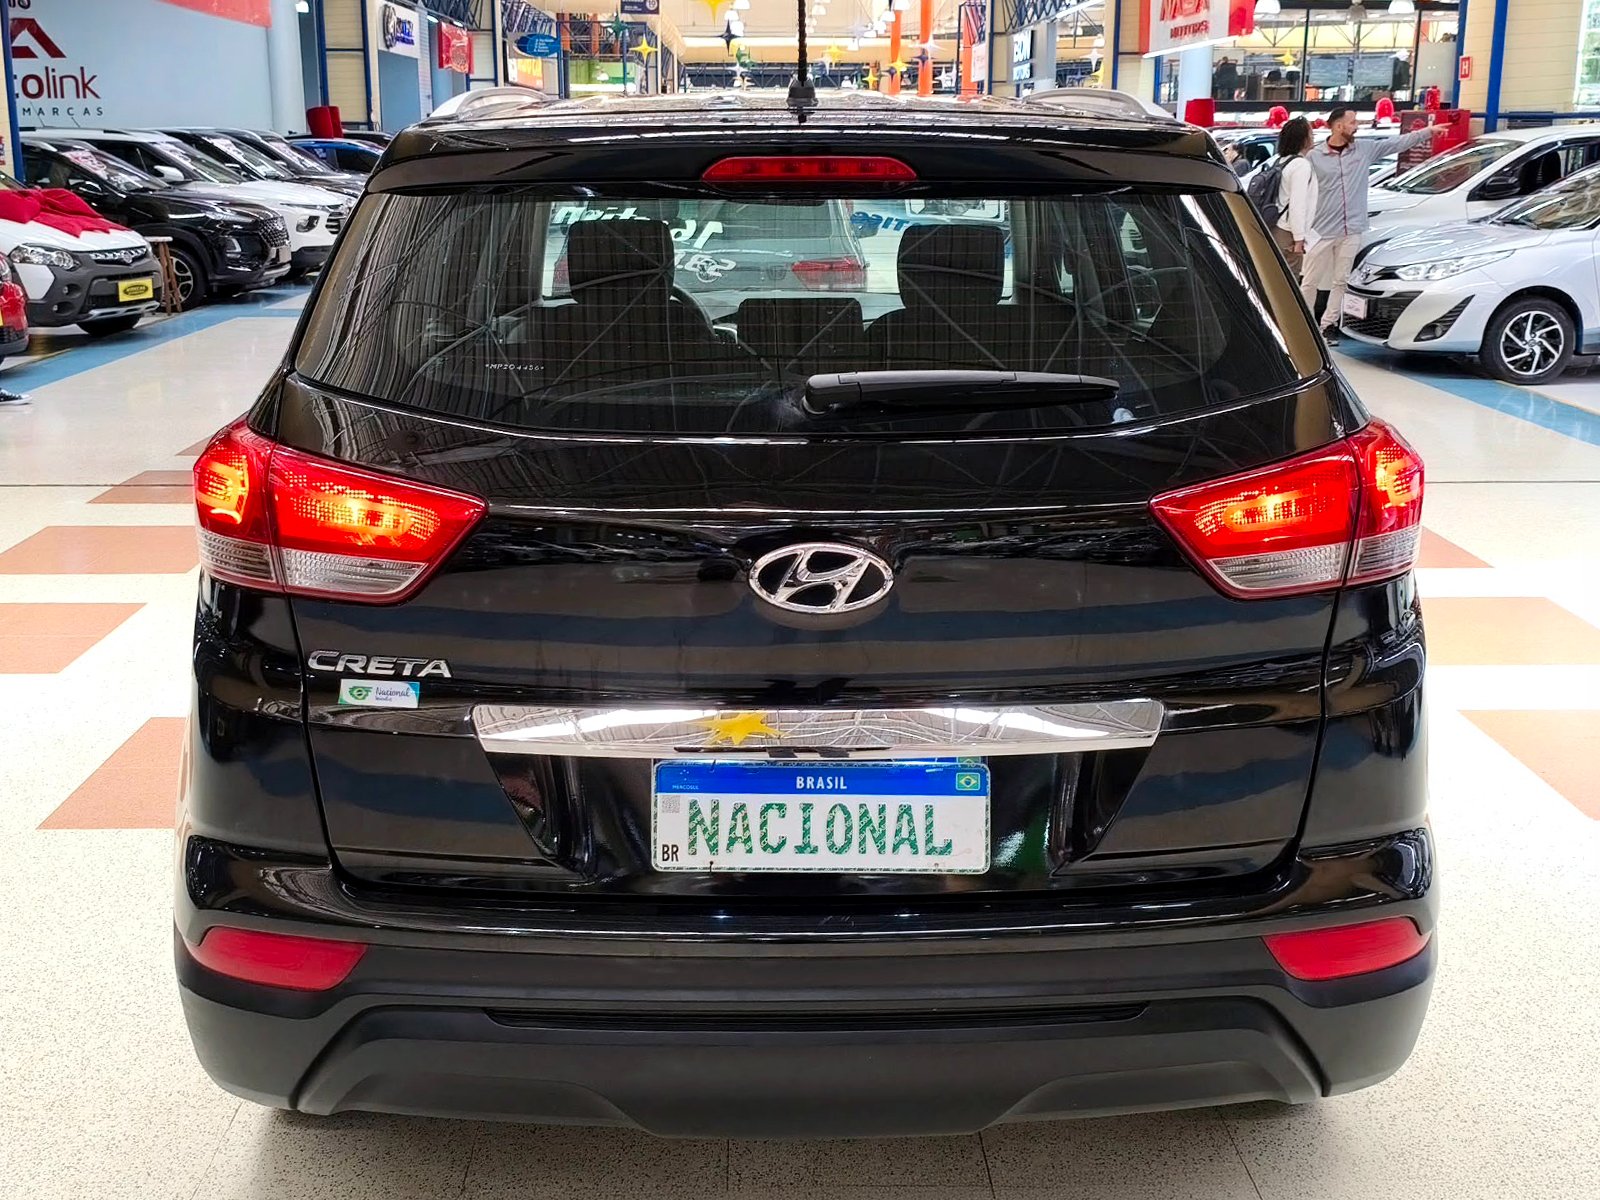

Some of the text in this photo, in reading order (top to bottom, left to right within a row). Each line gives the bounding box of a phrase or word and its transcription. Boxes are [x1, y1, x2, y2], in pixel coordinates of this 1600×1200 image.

[1461, 60, 1469, 75] H
[14, 66, 101, 99] olink
[22, 107, 104, 116] MARCAS
[307, 650, 453, 678] CRETA
[375, 686, 411, 698] Nacional
[796, 776, 848, 790] BRASIL
[688, 799, 953, 856] NACIONAL
[661, 844, 680, 862] BR
